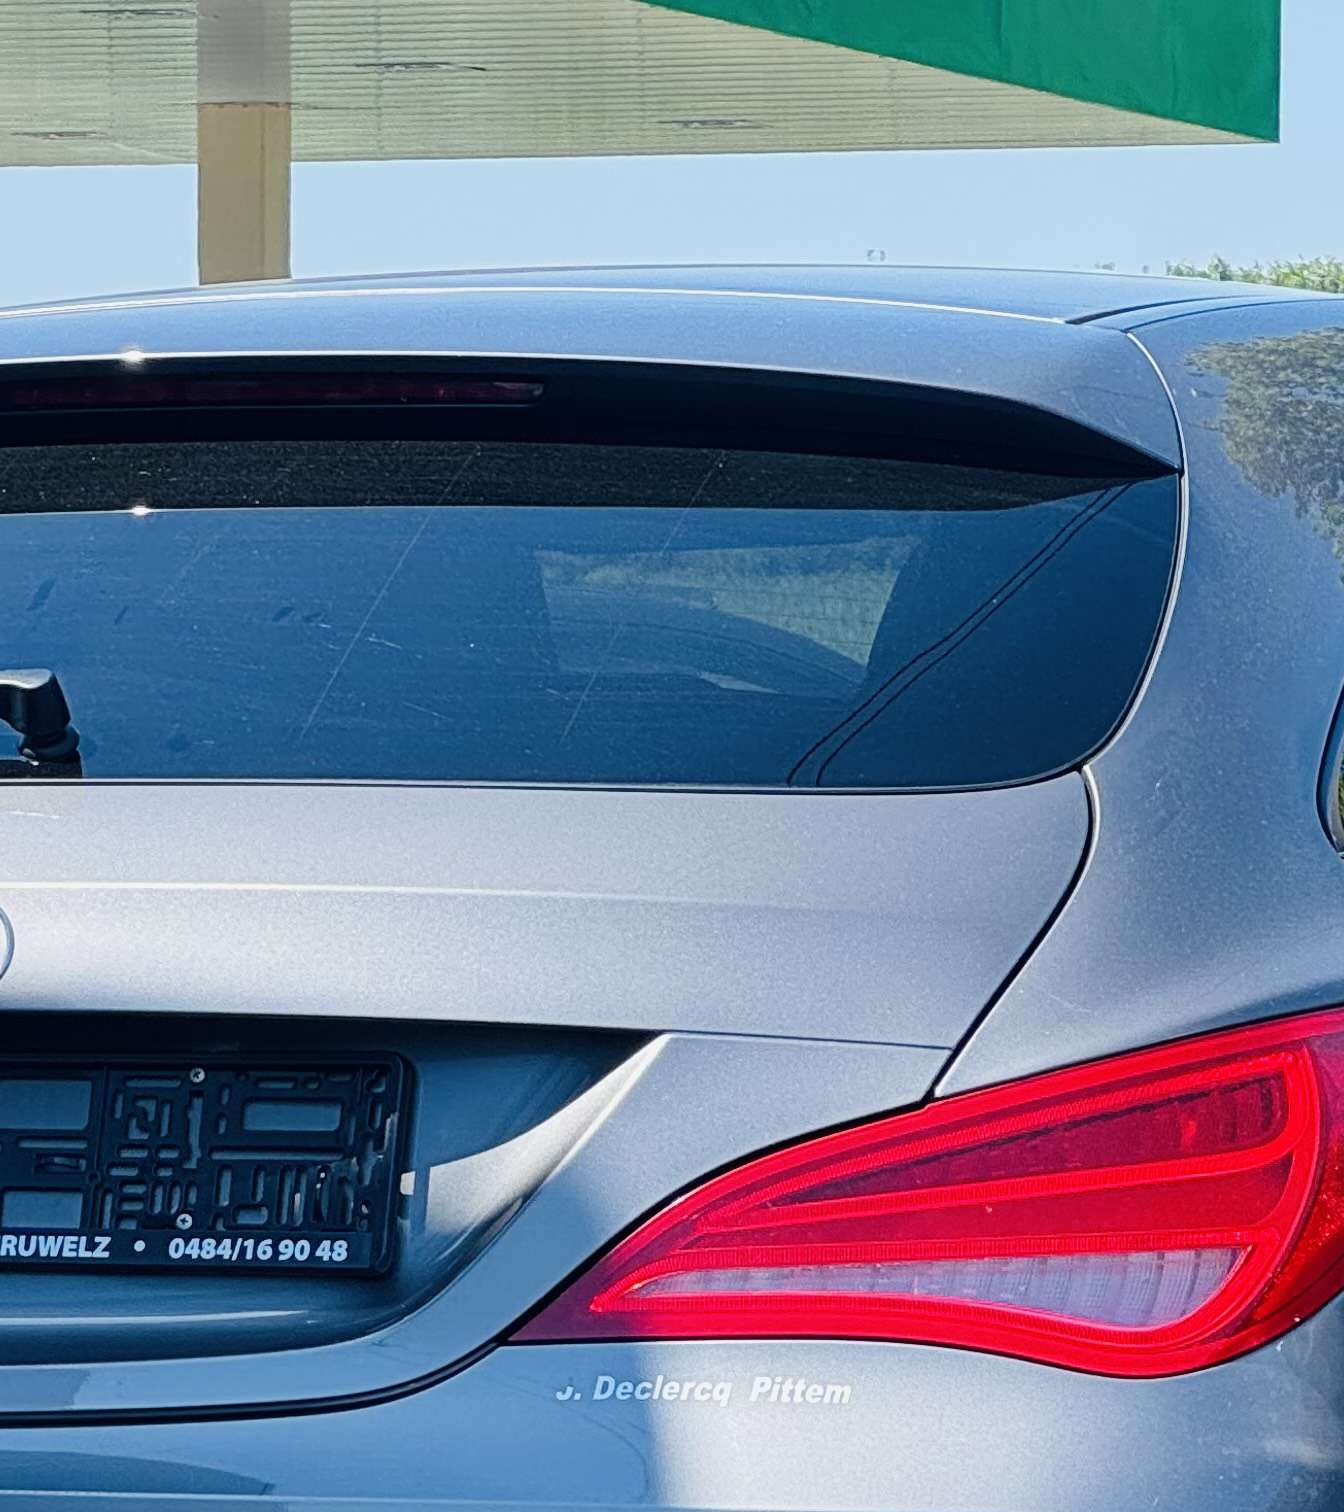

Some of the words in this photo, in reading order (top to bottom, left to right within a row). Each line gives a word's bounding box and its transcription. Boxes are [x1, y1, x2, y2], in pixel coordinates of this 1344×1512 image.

[168, 1237, 273, 1262] 0484/16
[277, 1238, 311, 1262] 90
[315, 1239, 349, 1262] 48
[593, 1375, 733, 1408] Declercq
[749, 1375, 853, 1405] Pittem
